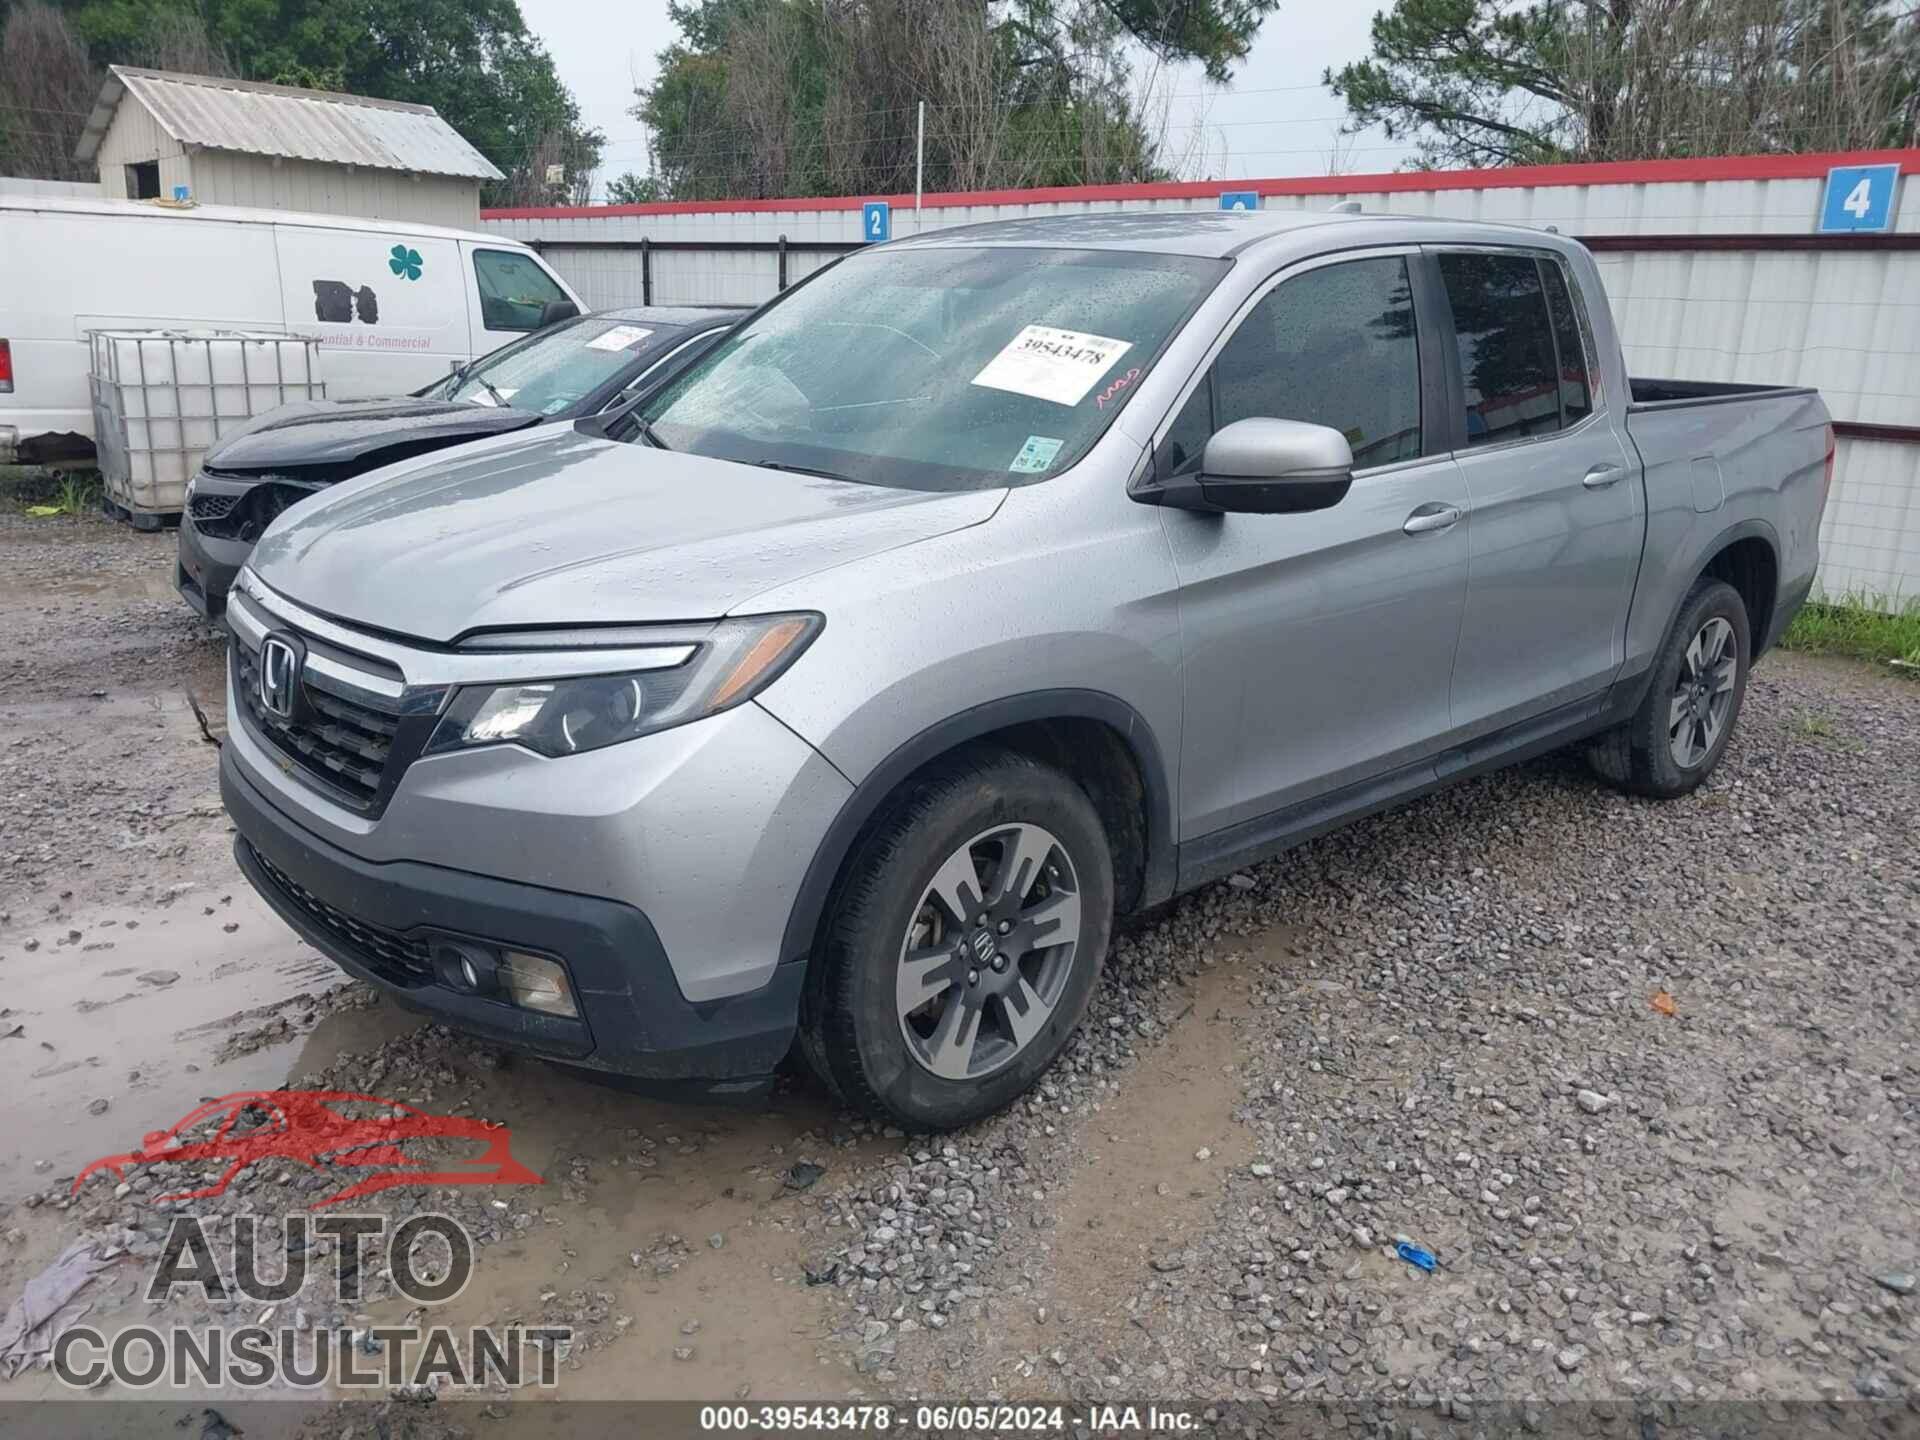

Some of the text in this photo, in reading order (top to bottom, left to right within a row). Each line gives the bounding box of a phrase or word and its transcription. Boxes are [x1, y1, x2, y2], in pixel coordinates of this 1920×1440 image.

[1843, 178, 1872, 218] 4
[871, 210, 881, 234] 2
[368, 335, 431, 349] Commercial
[1024, 338, 1106, 365] 39543478
